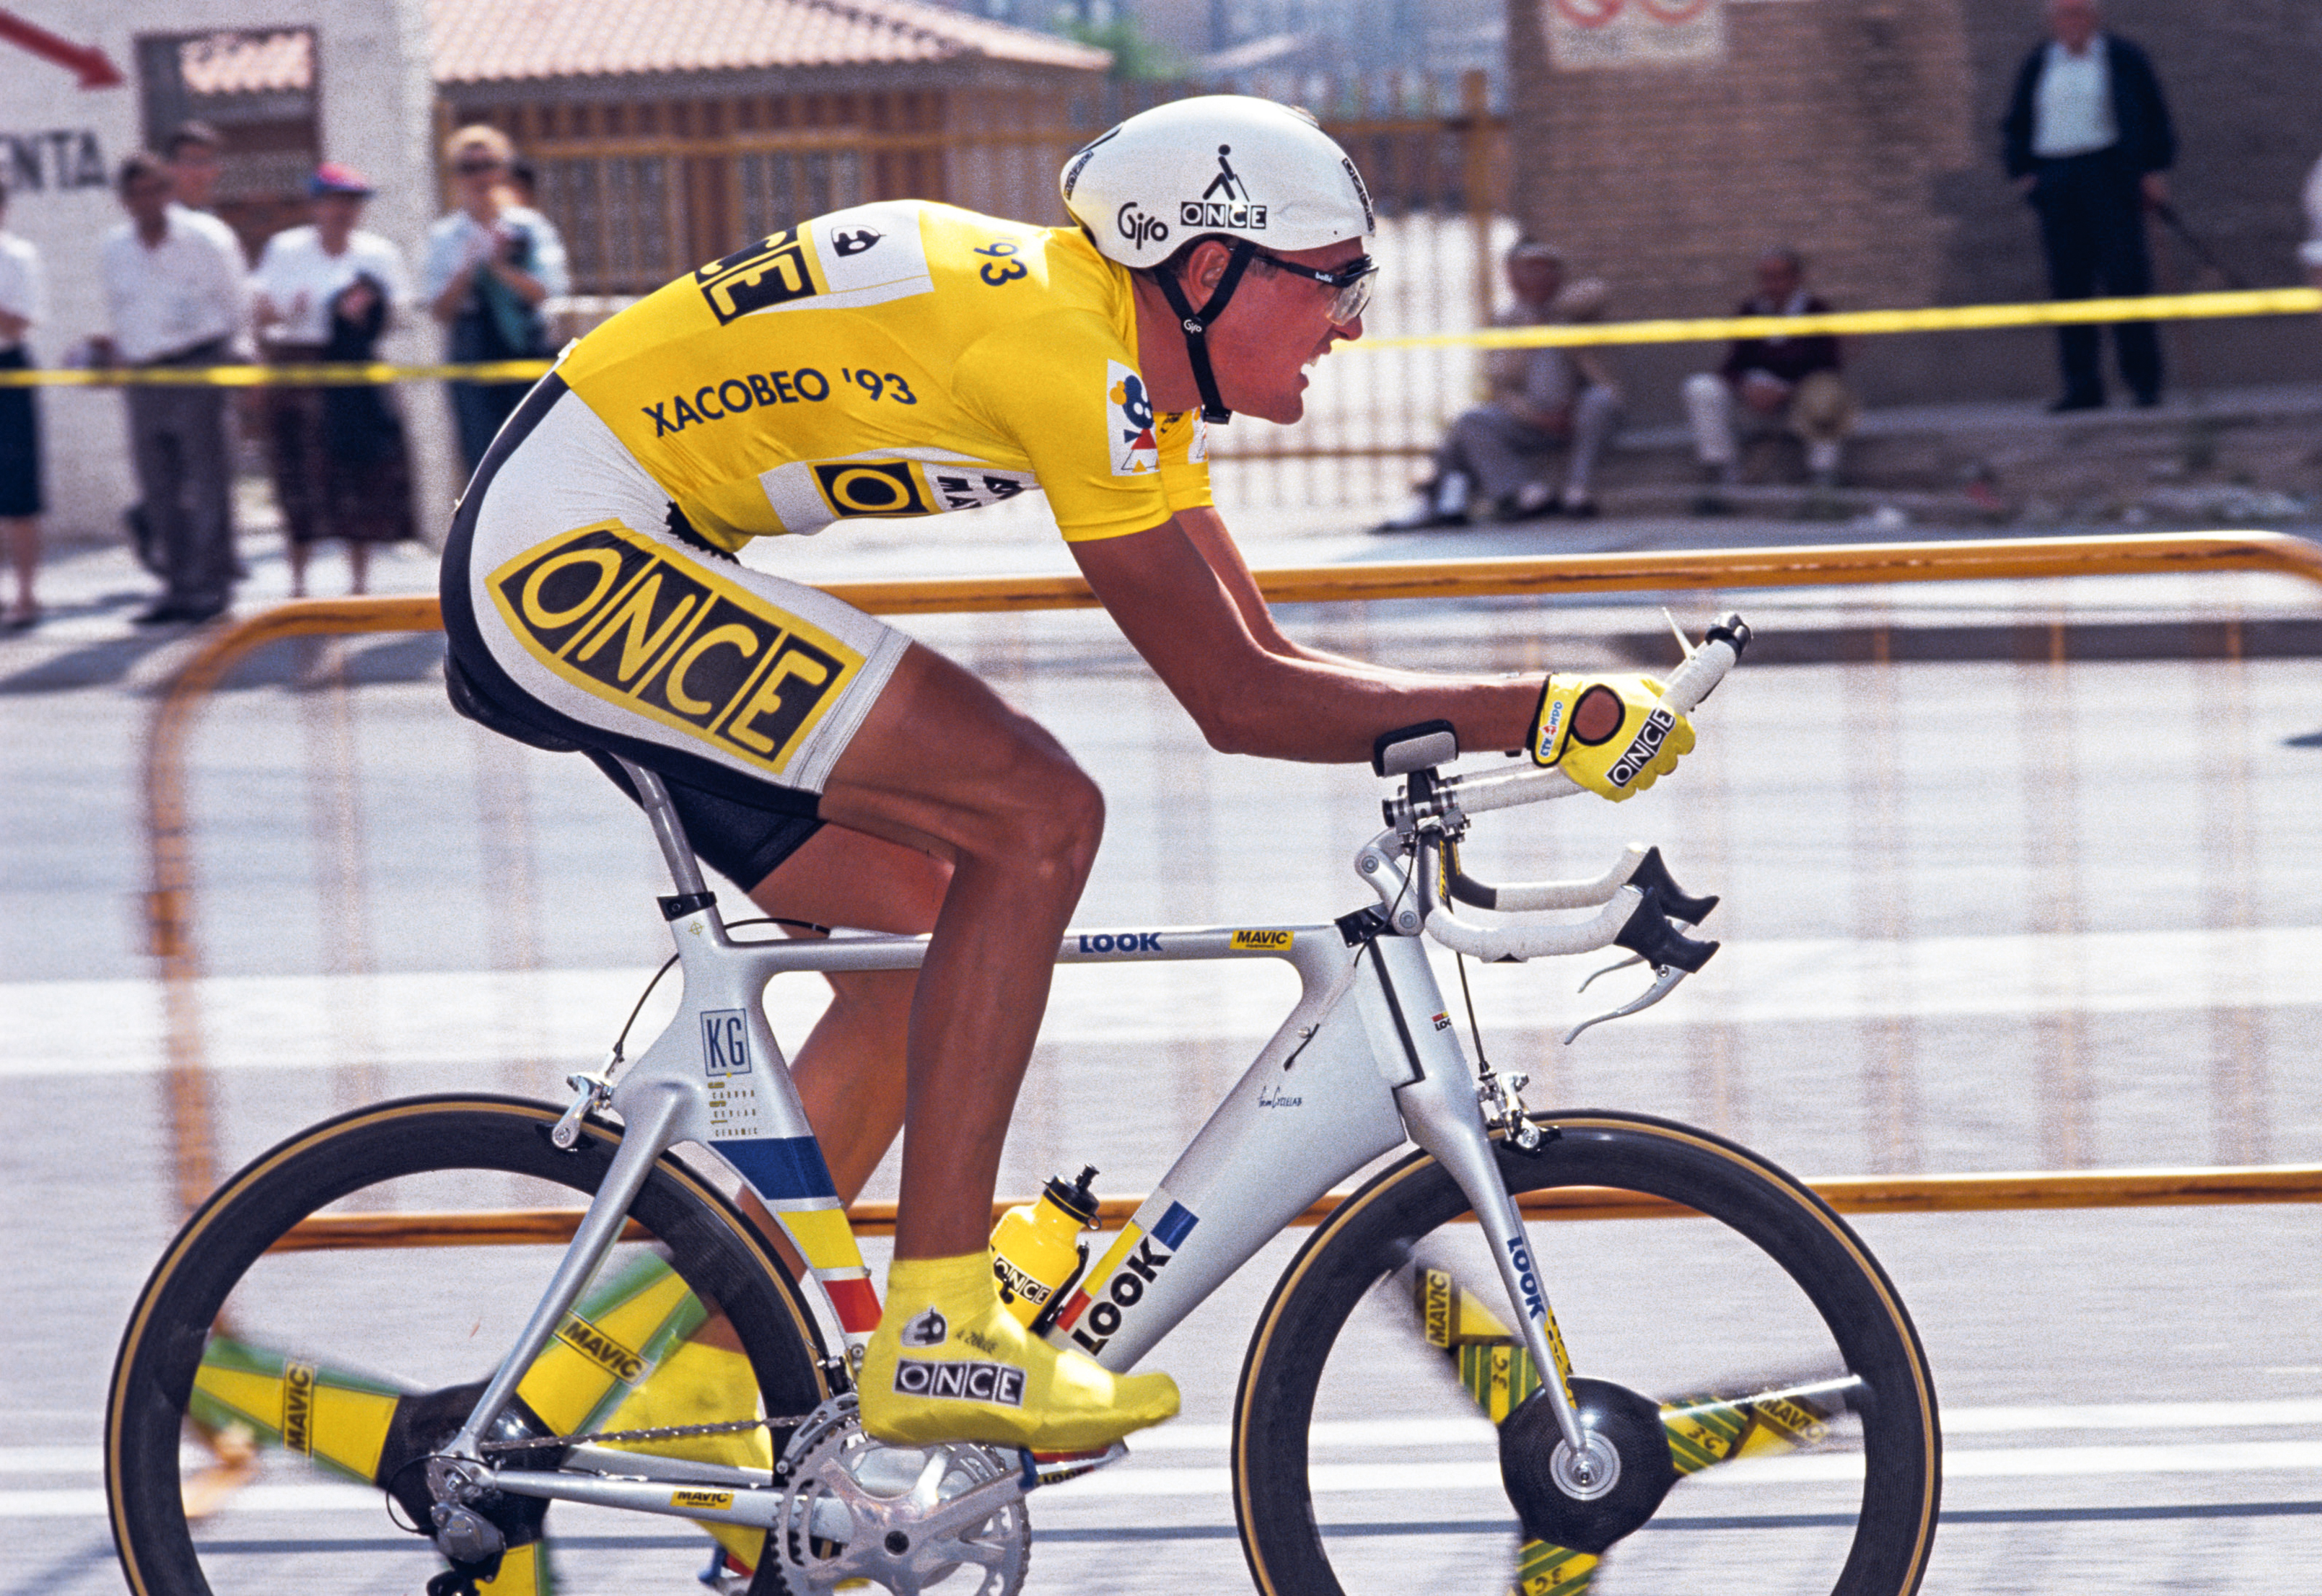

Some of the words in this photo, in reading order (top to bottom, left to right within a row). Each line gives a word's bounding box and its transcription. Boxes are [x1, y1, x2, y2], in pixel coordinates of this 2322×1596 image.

[1118, 201, 1169, 250] Giro
[1181, 203, 1266, 228] ONCE
[1183, 319, 1202, 333] Giro
[641, 368, 830, 437] XACOBEO
[841, 367, 917, 405] '93
[522, 548, 828, 753] ONCE
[1613, 708, 1674, 784] ONCE
[1079, 932, 1163, 953] LOOK
[1237, 931, 1288, 944] MAVIC
[706, 1017, 745, 1068] KG
[1072, 1235, 1172, 1356] LOOK
[1507, 1236, 1546, 1320] LOOK
[1428, 1273, 1447, 1343] MAVIC
[564, 1320, 642, 1377] MAVIC
[287, 1367, 310, 1452] MAVIC
[900, 1364, 1022, 1402] ONCE
[677, 1491, 730, 1503] MAVIC
